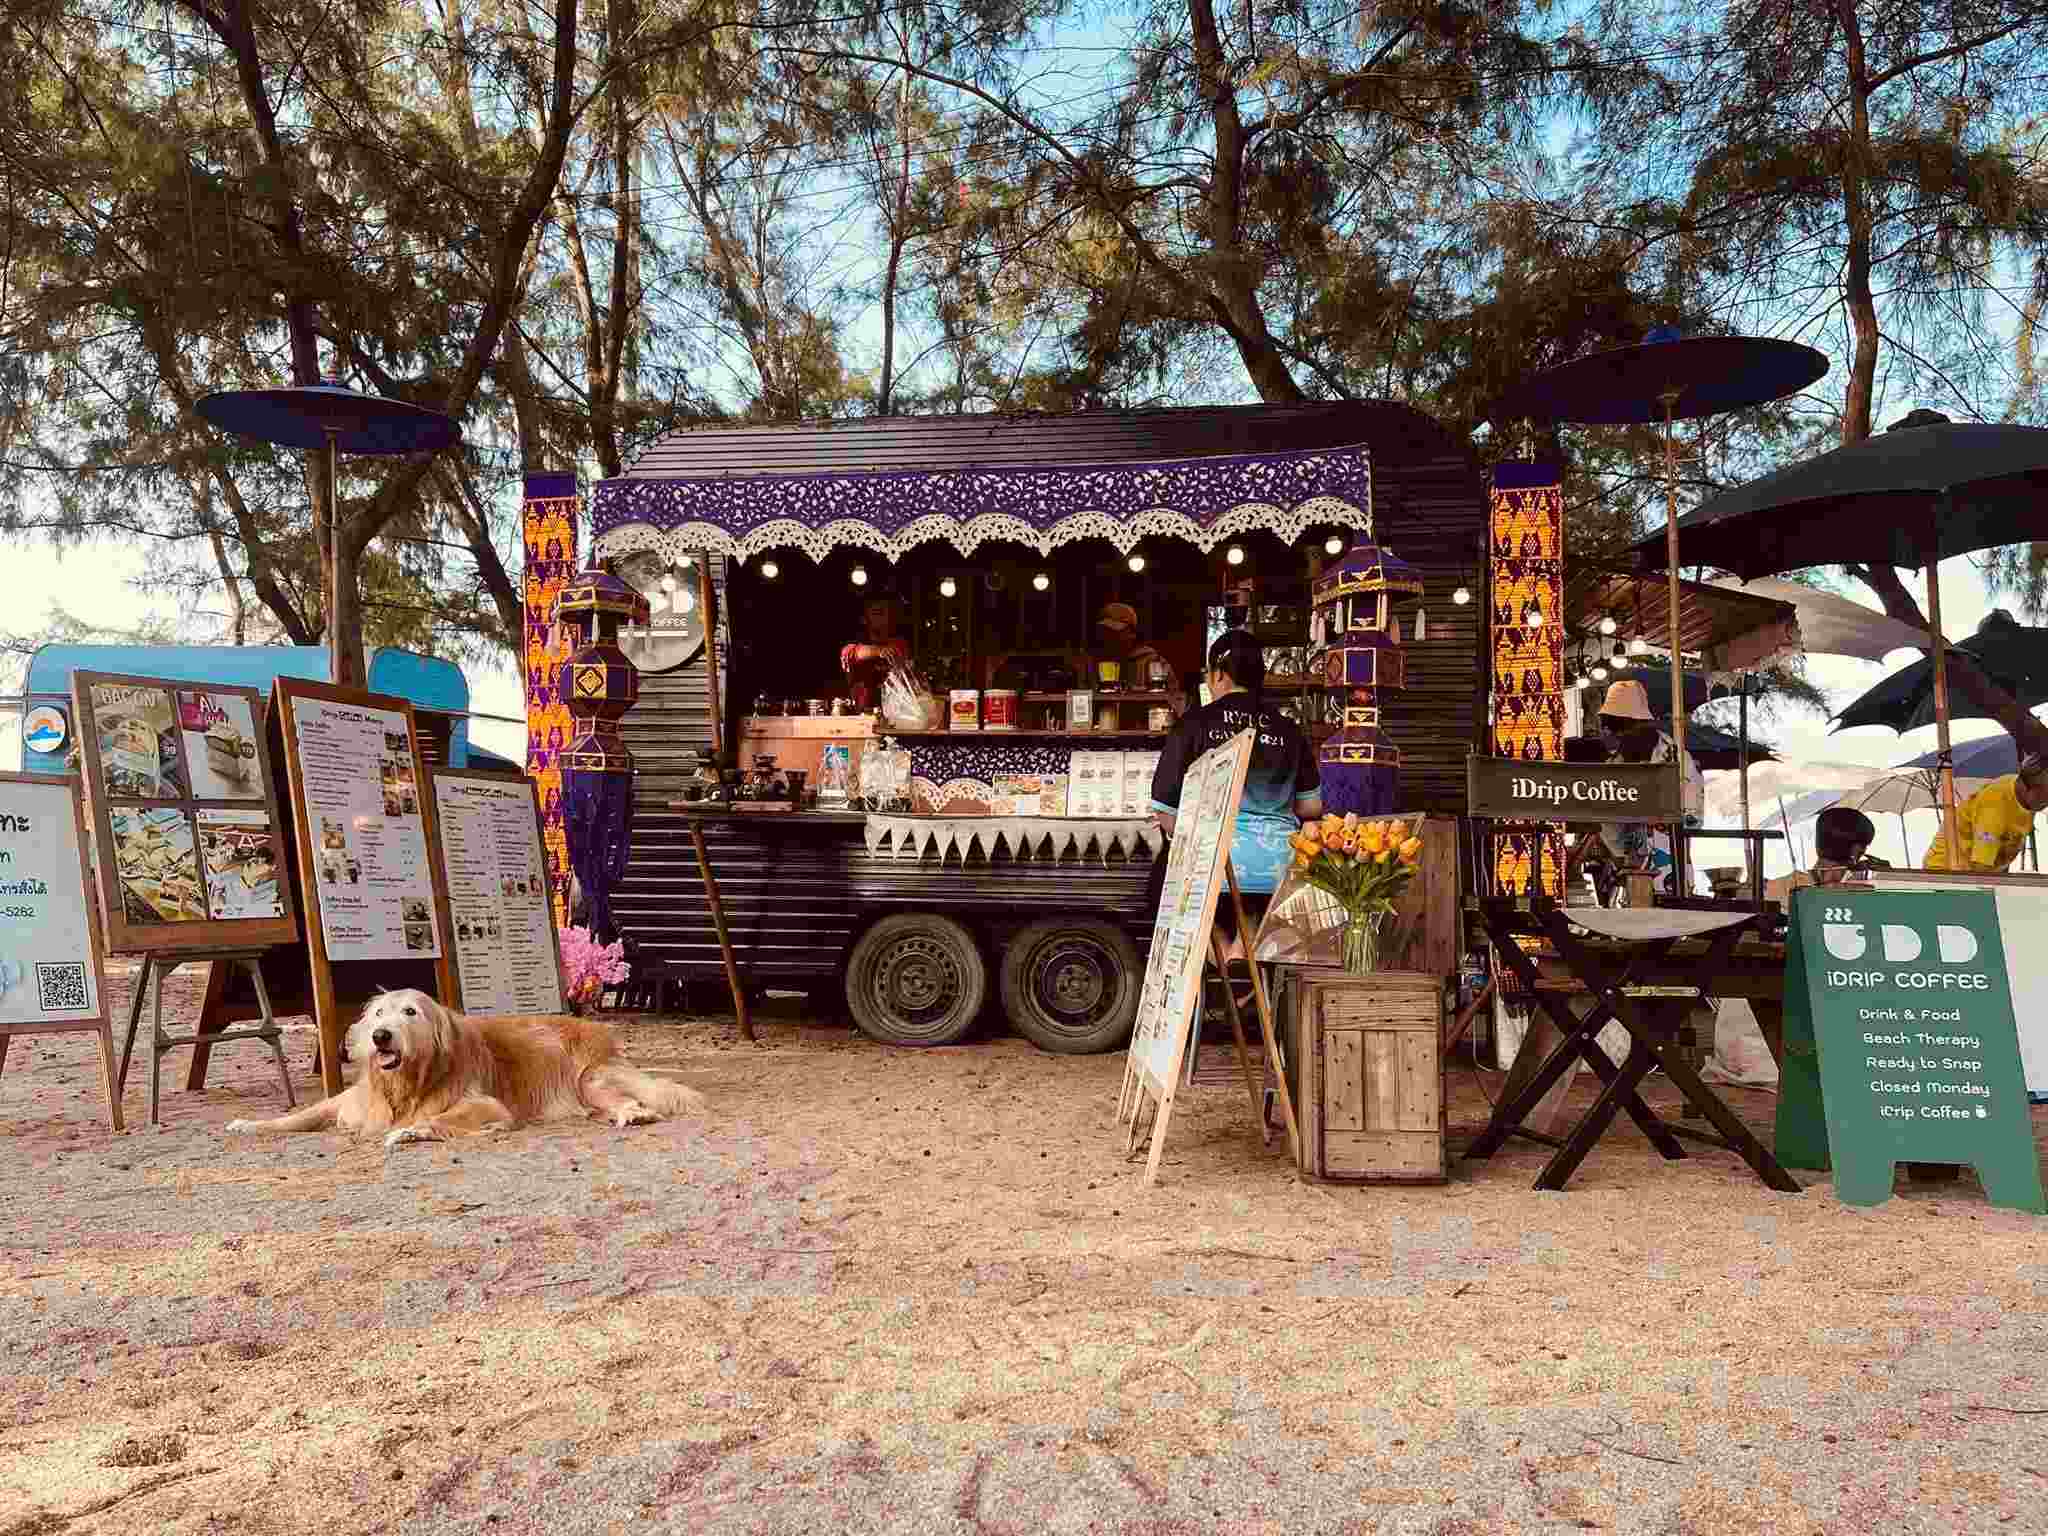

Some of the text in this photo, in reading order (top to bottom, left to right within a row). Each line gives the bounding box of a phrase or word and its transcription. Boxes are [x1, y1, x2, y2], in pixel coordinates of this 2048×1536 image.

[1512, 777, 1639, 805] iDrip Coffee
[1826, 970, 1989, 989] iDRIP COFFEE
[1859, 1008, 1960, 1020] Drink & Food
[1864, 1032, 1980, 1048] Beach Therapy
[1866, 1056, 1982, 1072] Ready to Snap
[1870, 1080, 1990, 1097] Closed Monday
[1920, 1105, 1970, 1118] Coffee
